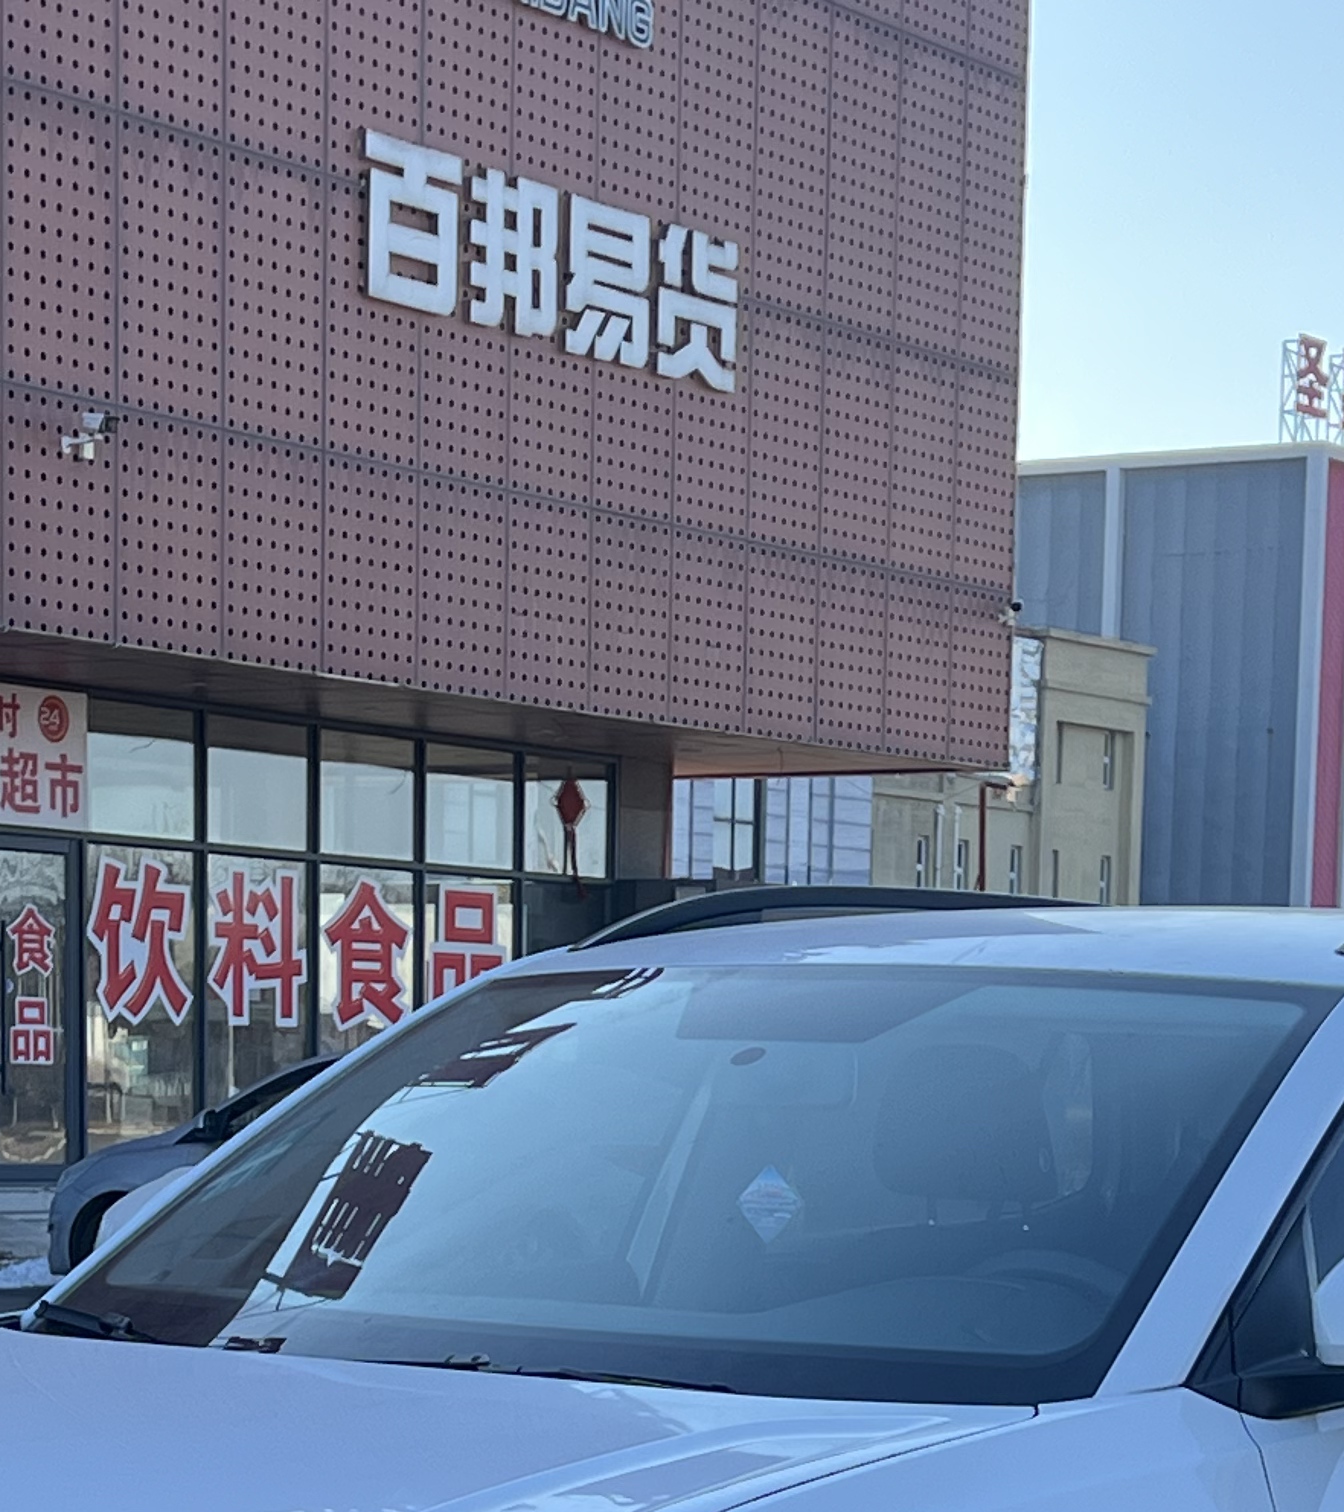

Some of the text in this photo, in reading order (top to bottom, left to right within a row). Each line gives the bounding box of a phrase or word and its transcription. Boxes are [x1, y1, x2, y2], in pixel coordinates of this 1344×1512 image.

[362, 128, 739, 393] 百邦易货
[88, 855, 507, 1030] 饮料食品
